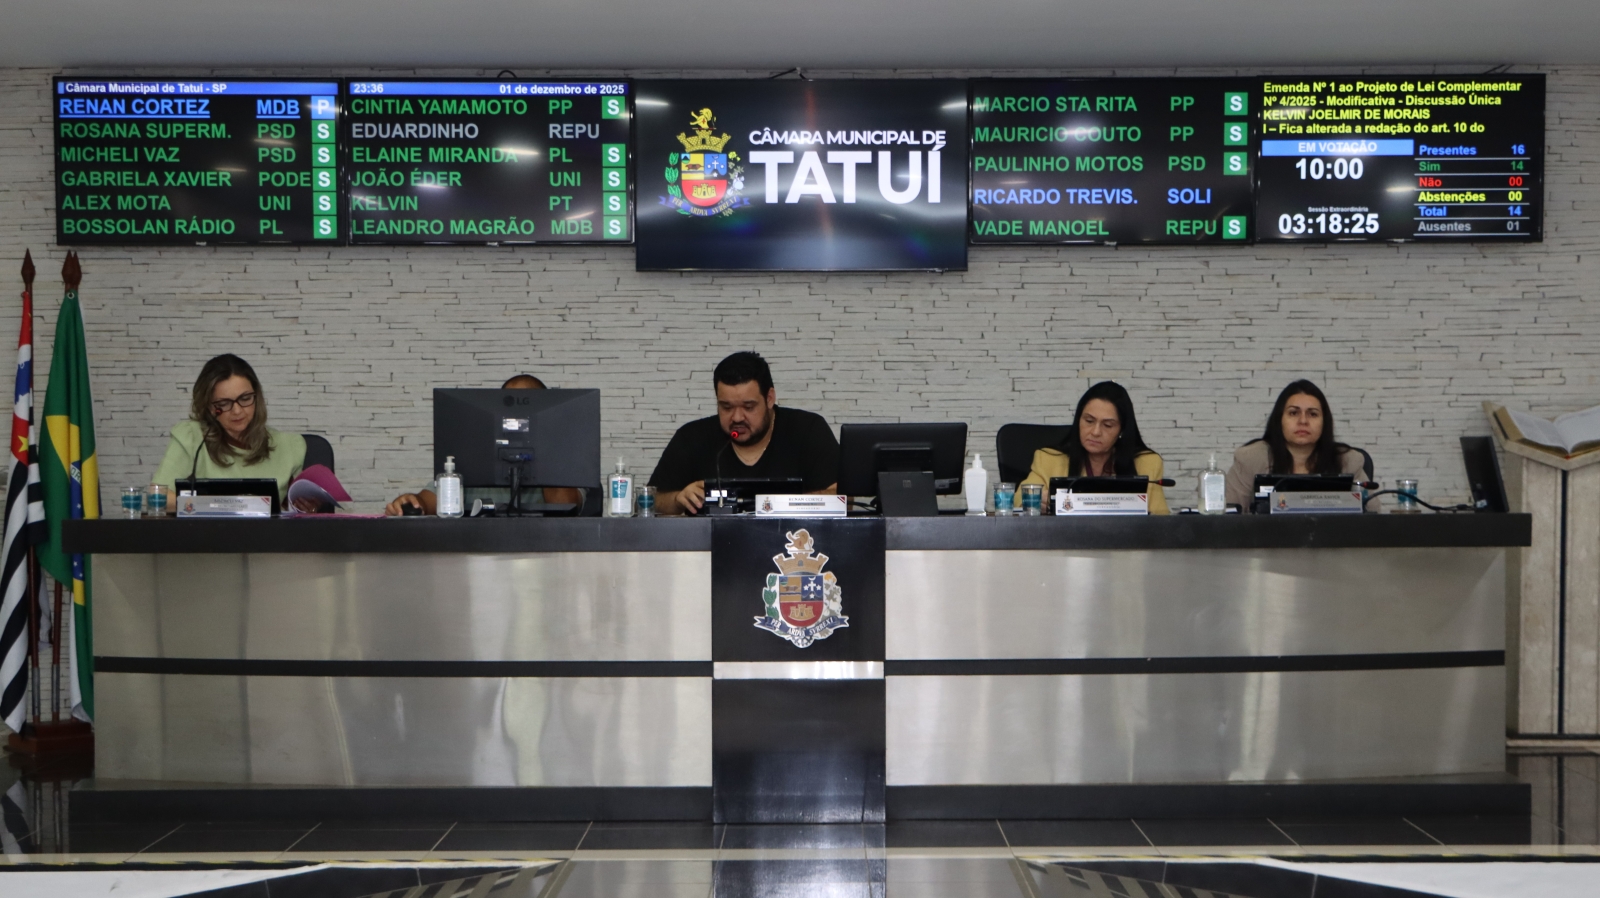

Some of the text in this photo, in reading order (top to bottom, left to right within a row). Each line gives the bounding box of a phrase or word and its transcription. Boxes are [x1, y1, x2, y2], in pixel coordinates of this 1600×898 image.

[66, 83, 106, 93] Câmara
[109, 83, 160, 95] Municipal
[162, 83, 175, 93] de
[212, 84, 227, 93] SP
[354, 84, 624, 94] 23:36 01 de dezembro de 2025
[1264, 83, 1310, 92] Emenda
[1330, 82, 1335, 92] 1
[1356, 82, 1397, 94] Projeto
[1400, 82, 1414, 92] de
[1418, 82, 1434, 91] Lei
[1438, 81, 1521, 93] Complementar
[60, 99, 329, 114] RENAN CORTEZ MDB P
[976, 96, 1242, 111] MARCIO STA RITA PP S
[1279, 96, 1316, 106] 4/2025
[1327, 96, 1395, 106] Modificativa
[1406, 95, 1465, 105] Discussão
[1469, 93, 1501, 105] Única
[352, 99, 620, 115] CINTIA YAMAMOTO PP S
[1264, 110, 1430, 120] KELVIN JOELMIR DE MORAIS
[61, 123, 329, 138] ROSANA SUPERM. PSD S
[352, 124, 599, 138] EDUARDINHO REPU
[749, 127, 946, 145] CÂMARA MUNICIPAL DE
[975, 126, 1242, 142] MAURICIO COUTO PP S
[1264, 124, 1266, 133] I
[1279, 124, 1305, 133] Fica
[1308, 124, 1352, 133] alterada
[1365, 123, 1410, 135] redação
[1414, 123, 1428, 133] do
[1431, 124, 1450, 133] art.
[1454, 123, 1467, 132] 10
[1470, 123, 1484, 132] do
[1298, 141, 1377, 154] EM VOTAÇÃO
[1419, 145, 1524, 155] Presentes 16
[61, 148, 330, 162] MICHELI VAZ PSD S
[353, 148, 620, 162] ELAINE MIRANDA PL S
[975, 156, 1241, 171] PAULINHO MOTOS PSD S
[1296, 158, 1363, 180] 10:00
[1419, 161, 1524, 171] Sim 14
[62, 172, 331, 186] GABRIELA XAVIER PODE S
[352, 168, 620, 186] JOÃO ÉDER UNI S
[750, 144, 945, 204] TATUÍ
[1420, 177, 1522, 187] Não 00
[62, 196, 331, 211] ALEX MOTA UNI S
[352, 196, 621, 211] KELVIN PT S
[974, 189, 1211, 204] RICARDO TREVIS. SOLI
[1419, 191, 1522, 204] Abstenções 00
[1419, 206, 1521, 216] Total 14
[63, 216, 332, 235] BOSSOLAN RÁDIO PL S
[353, 216, 621, 235] LEANDRO MAGRÃO MDB S
[974, 220, 1240, 235] VADE MANOEL REPU S
[1278, 213, 1379, 234] 03:18:25
[1418, 221, 1520, 232] Ausentes 01
[516, 396, 530, 406] LG
[771, 618, 781, 628] PER
